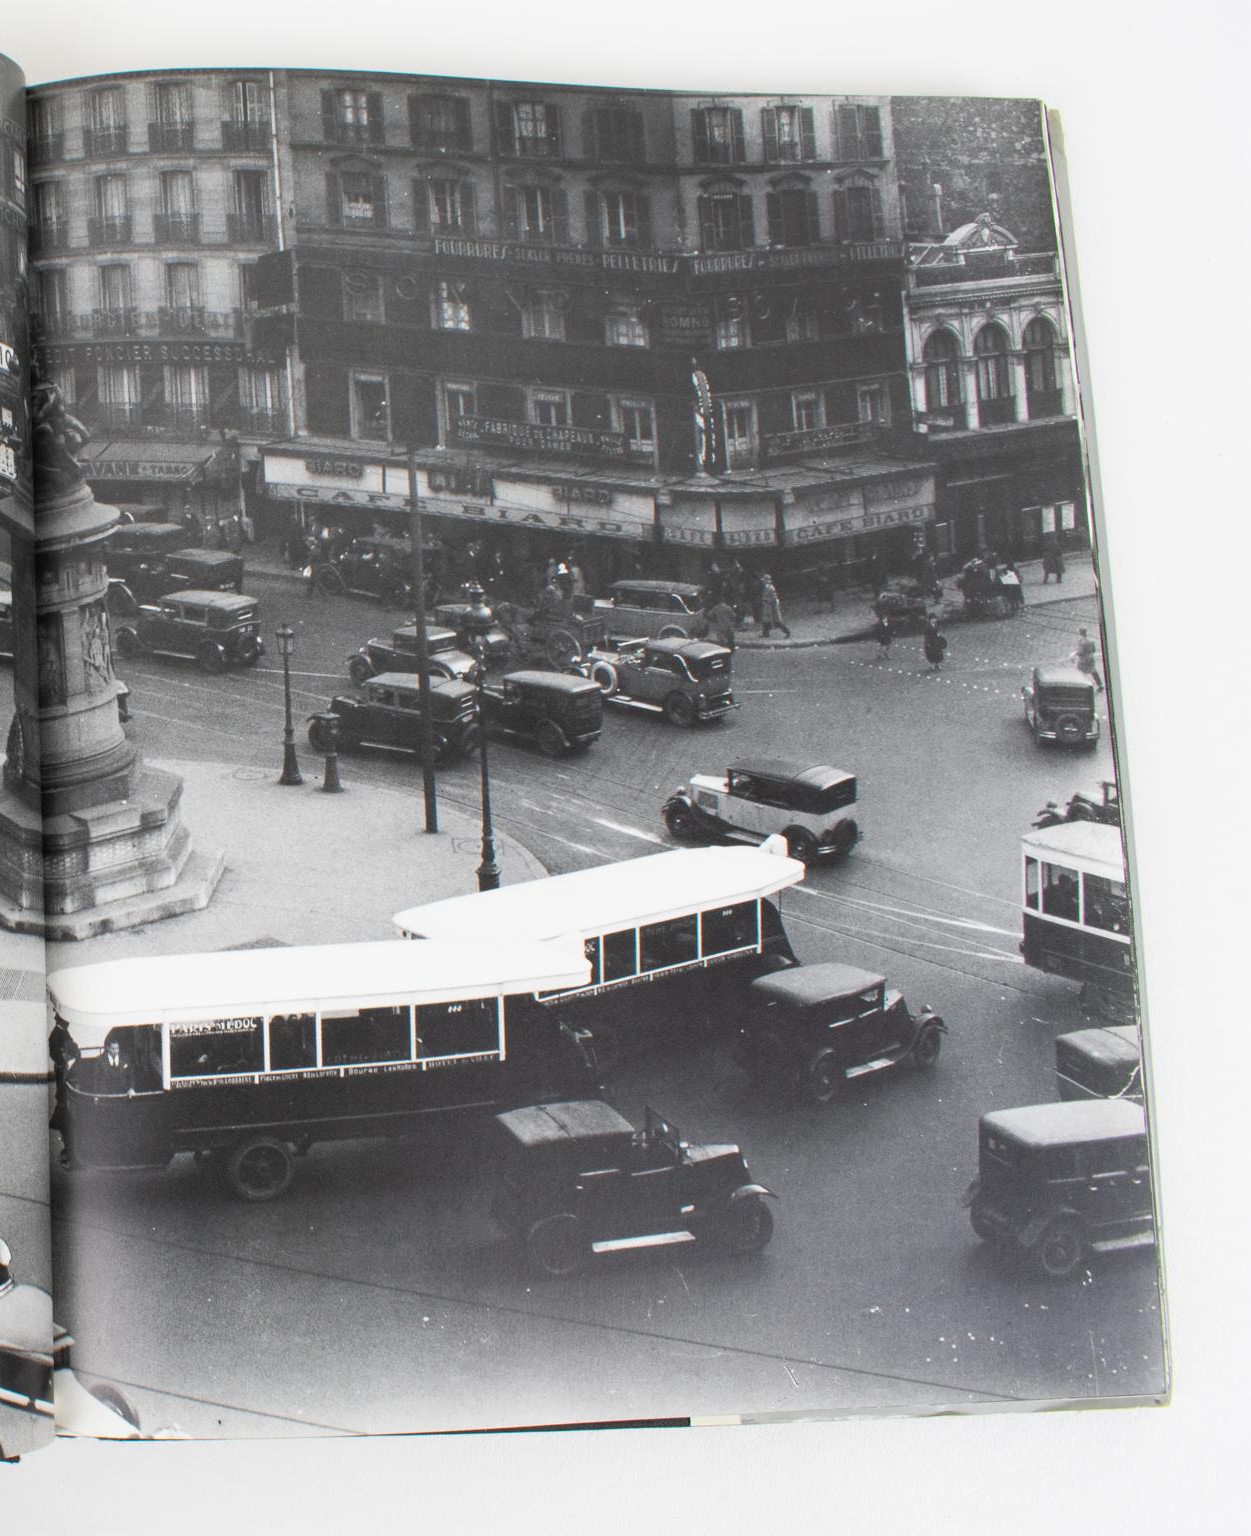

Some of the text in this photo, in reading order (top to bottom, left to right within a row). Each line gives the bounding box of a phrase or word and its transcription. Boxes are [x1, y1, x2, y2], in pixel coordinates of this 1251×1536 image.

[434, 239, 508, 260] FOURRURES
[84, 345, 153, 362] FONCIER
[484, 420, 531, 438] FABRIQUE
[546, 428, 595, 445] CHAPEAUX
[462, 504, 623, 534] BIARD
[796, 508, 925, 541] CAFE BIARD
